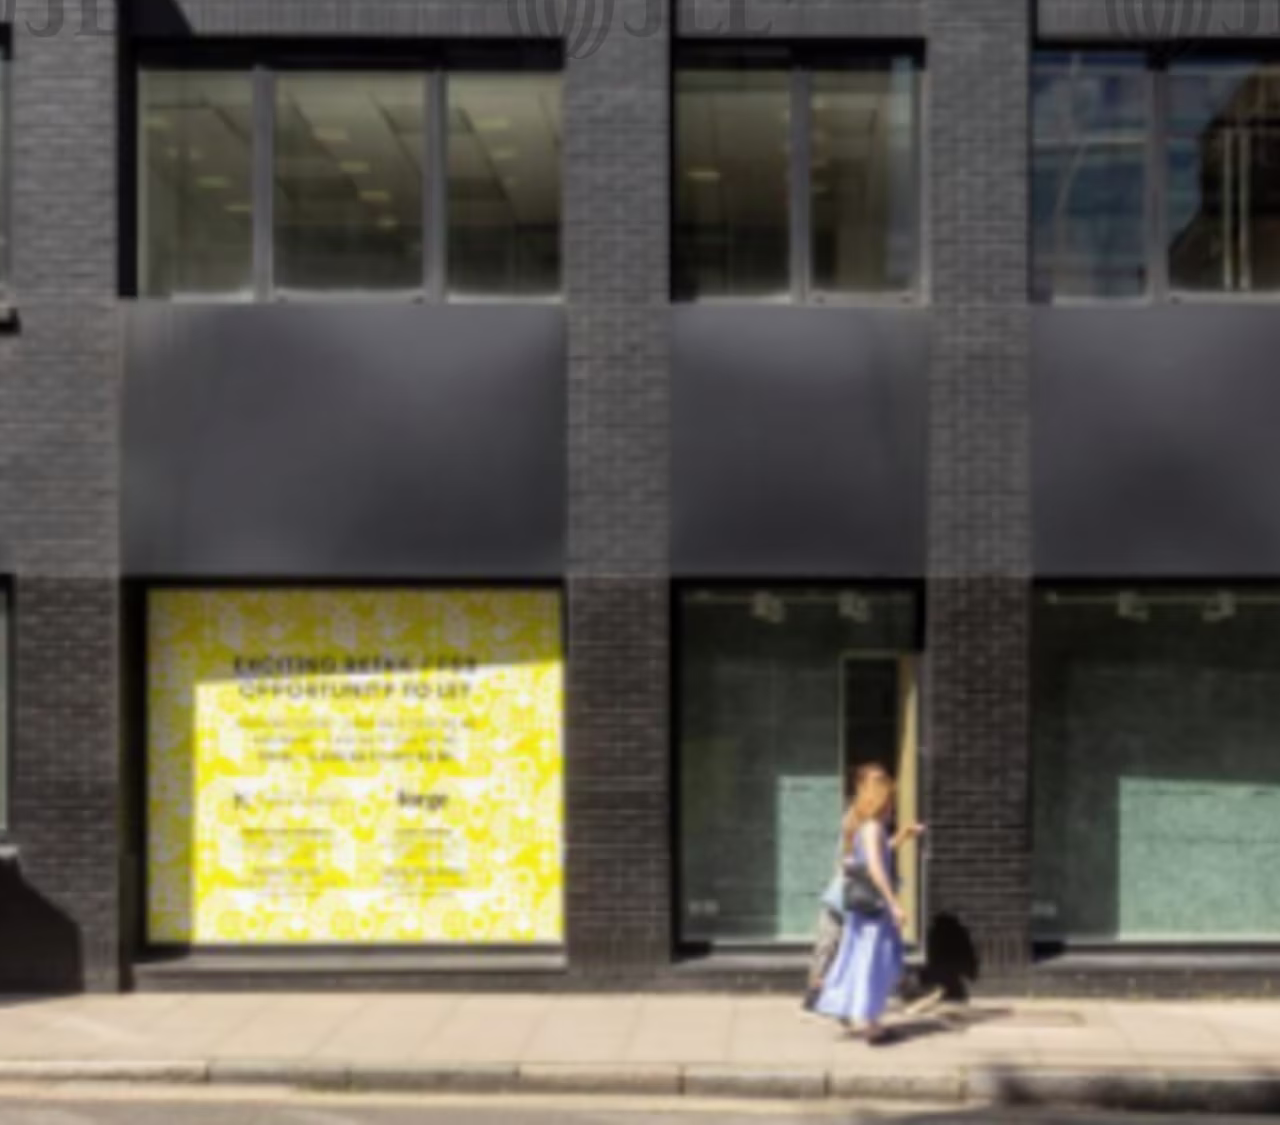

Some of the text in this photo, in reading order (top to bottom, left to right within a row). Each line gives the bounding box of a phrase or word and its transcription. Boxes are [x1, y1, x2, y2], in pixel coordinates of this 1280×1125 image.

[237, 682, 472, 700] OPPORTUNITY TO LET
